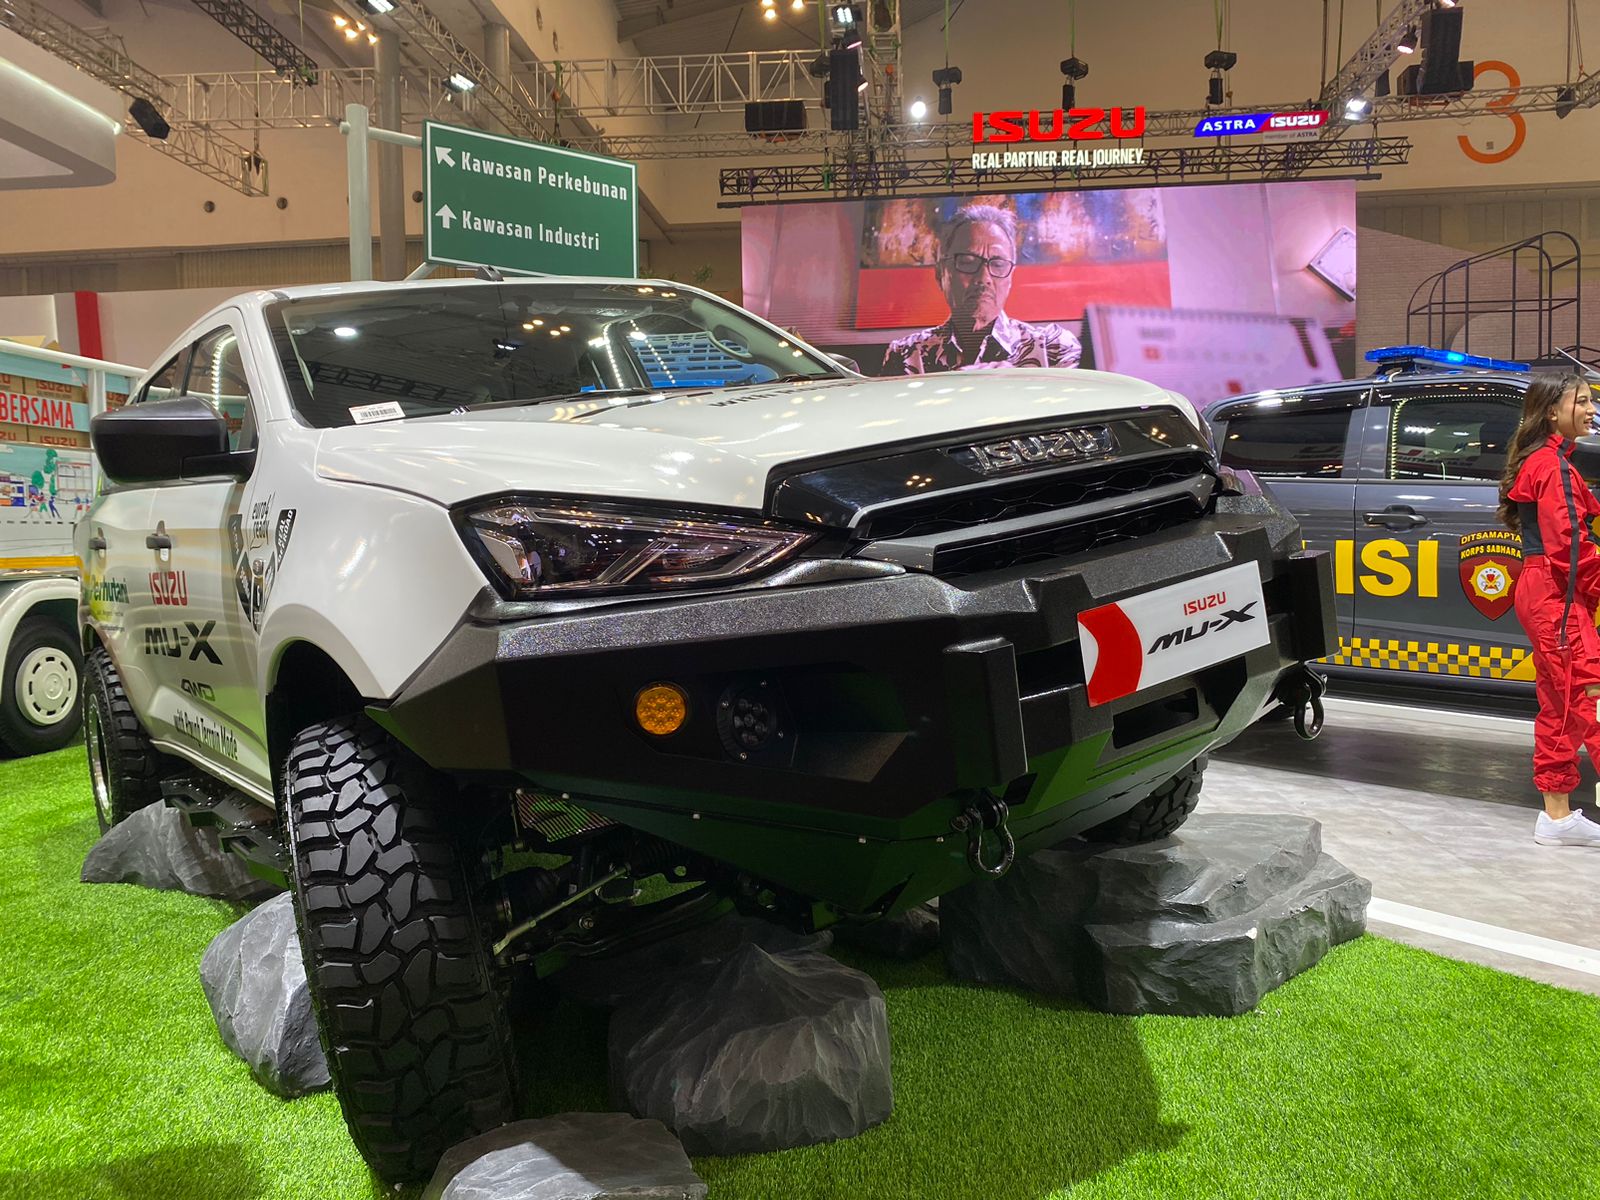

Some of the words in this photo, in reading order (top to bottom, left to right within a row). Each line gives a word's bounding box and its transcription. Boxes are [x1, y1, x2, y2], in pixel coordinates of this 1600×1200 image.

[972, 106, 1146, 144] ISUZU
[1202, 119, 1256, 132] ASTRA
[1270, 114, 1320, 127] ISUZU
[1457, 60, 1526, 164] 3
[1296, 130, 1318, 138] ASTRA
[461, 151, 532, 183] Kawasan
[538, 166, 627, 201] Perkebunan
[972, 153, 1002, 169] REAL
[1062, 150, 1092, 167] REAL
[1092, 148, 1145, 168] JOURNEY.
[462, 210, 533, 240] Kawasan
[539, 223, 600, 251] Industri
[0, 391, 75, 429] BERSAMA
[40, 435, 77, 447] ISUZU
[970, 429, 1099, 472] ISUZU
[253, 520, 271, 545] ready
[277, 518, 287, 547] REAL
[1461, 531, 1522, 544] DITSAMAPTA
[1301, 538, 1439, 598] ISI
[1460, 545, 1485, 559] KORPS
[1486, 545, 1522, 559] SABHARA
[149, 570, 188, 606] ISUZU
[1183, 591, 1227, 616] ISUZU
[145, 620, 224, 666] MU-X
[1147, 601, 1258, 655] MU-X
[220, 725, 238, 761] Mode
